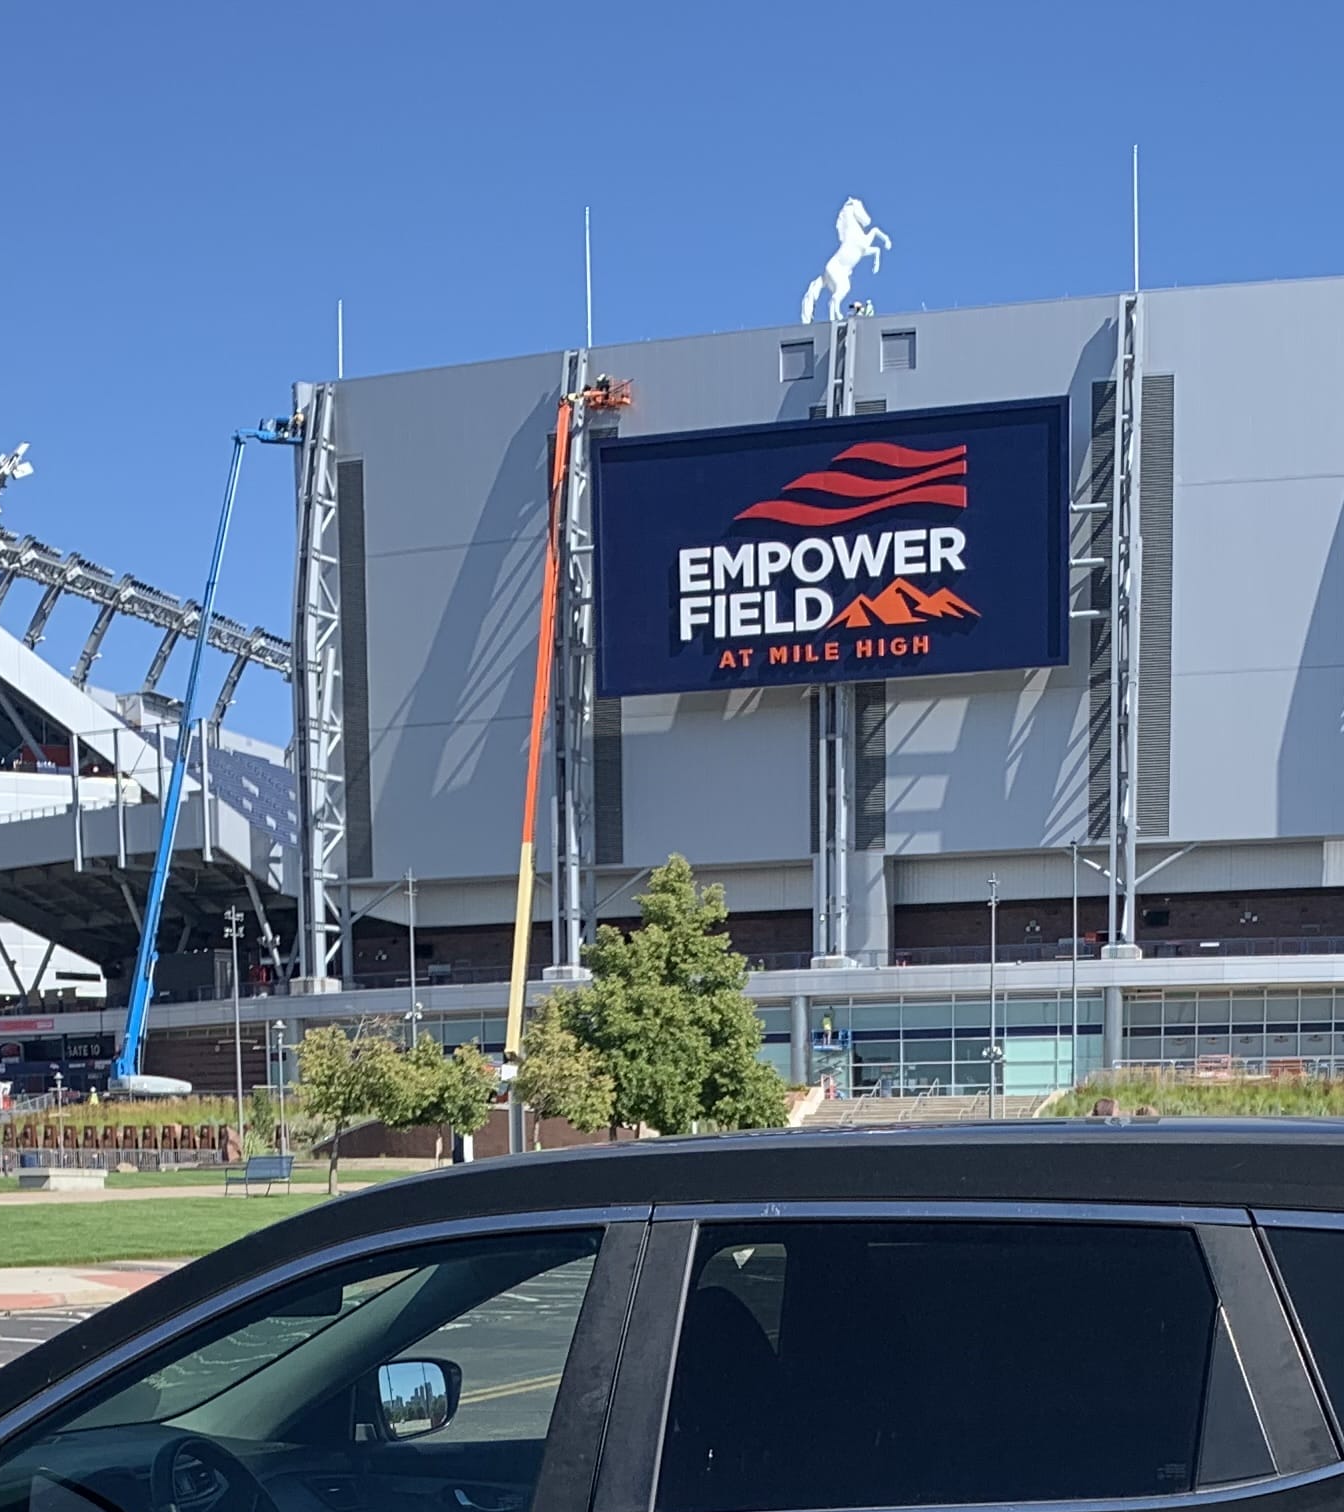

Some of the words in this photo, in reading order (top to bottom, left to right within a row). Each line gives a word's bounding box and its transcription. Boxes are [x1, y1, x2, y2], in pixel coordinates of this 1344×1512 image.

[679, 526, 966, 592] EMPOWER
[679, 587, 834, 641] FIELD
[719, 648, 754, 669] AT
[769, 641, 840, 664] MILE
[856, 635, 929, 658] HIGH
